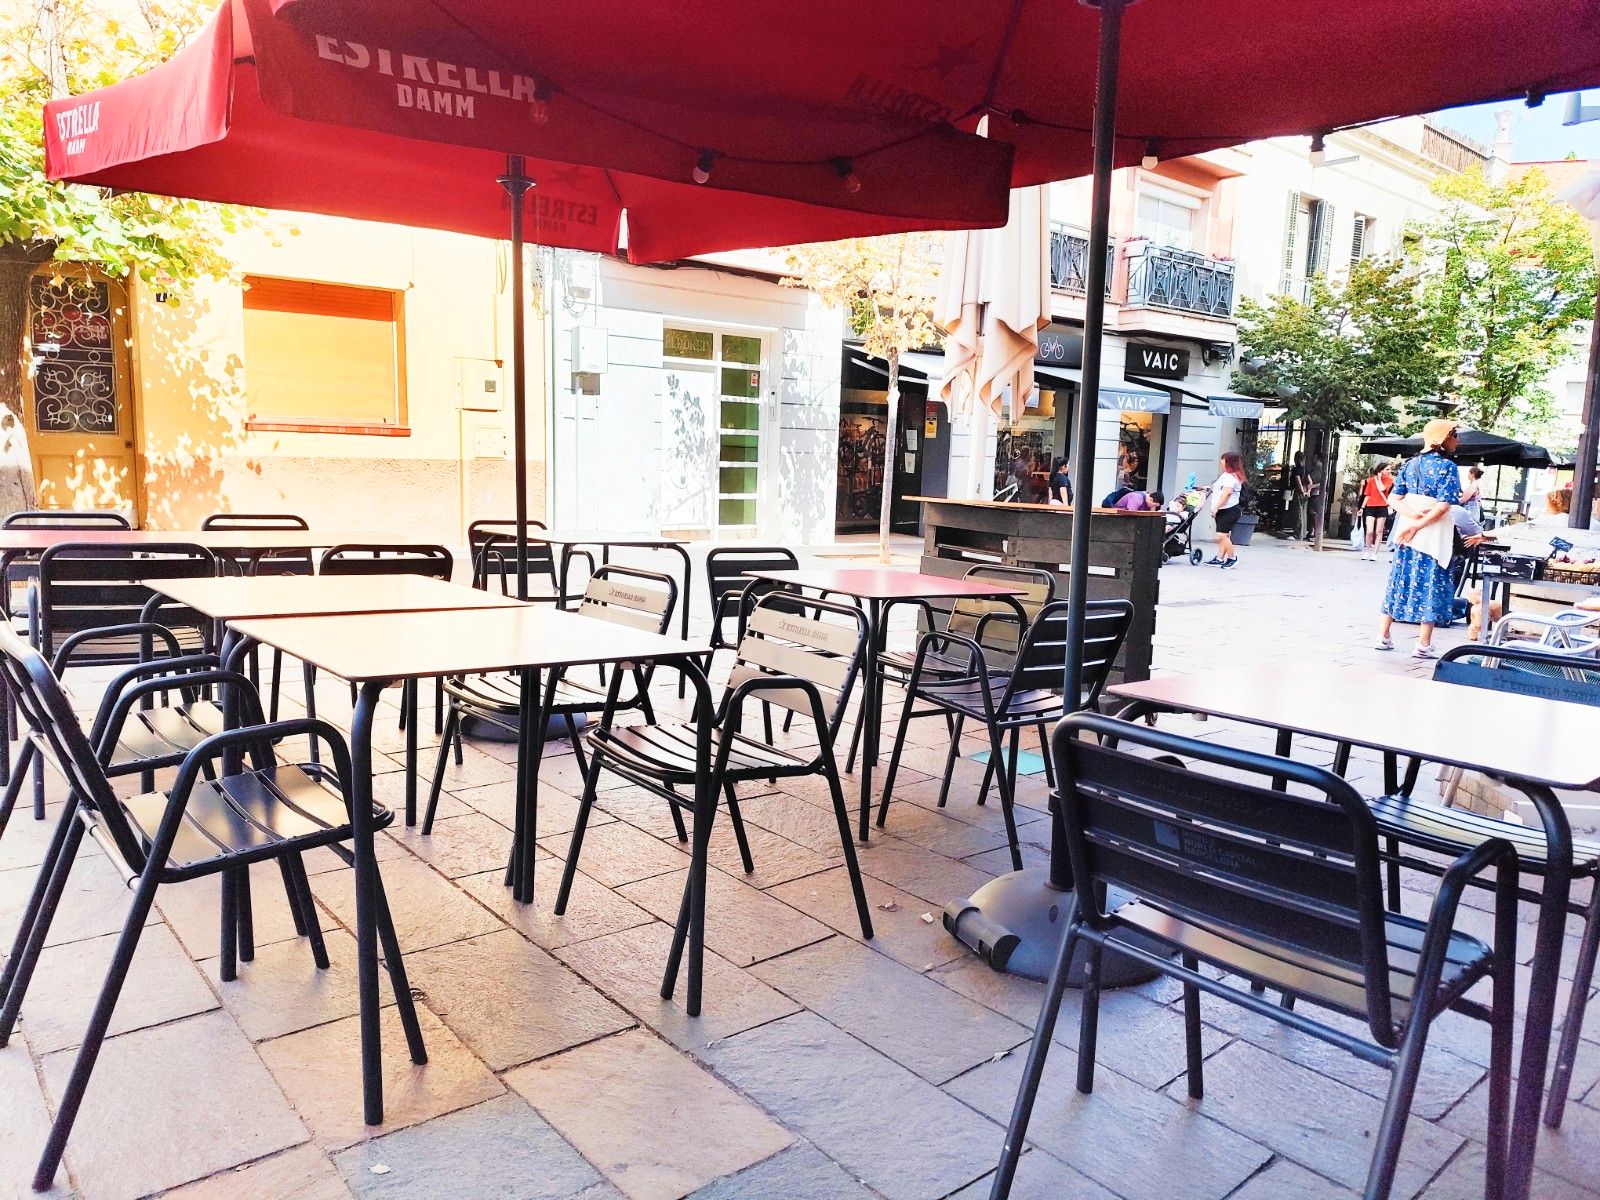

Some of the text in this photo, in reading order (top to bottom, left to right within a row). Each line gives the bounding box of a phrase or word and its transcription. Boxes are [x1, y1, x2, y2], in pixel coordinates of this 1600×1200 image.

[396, 83, 475, 119] DAMM
[1142, 350, 1179, 371] VAIC
[1116, 395, 1147, 410] VAIC
